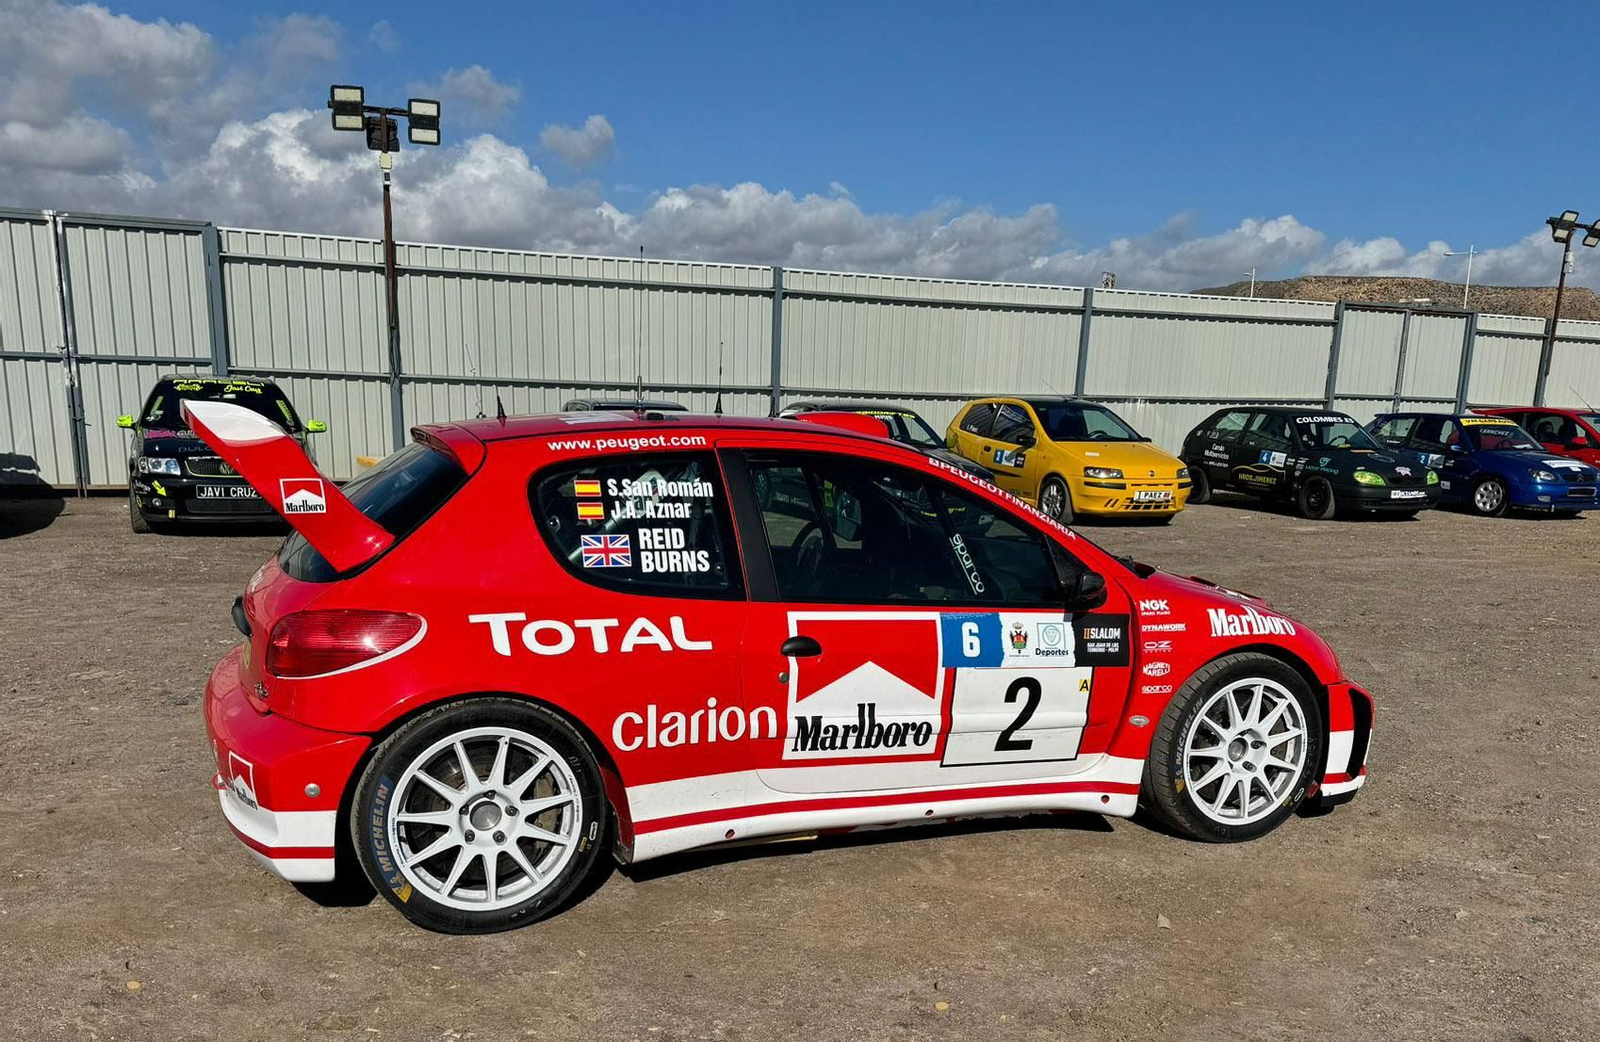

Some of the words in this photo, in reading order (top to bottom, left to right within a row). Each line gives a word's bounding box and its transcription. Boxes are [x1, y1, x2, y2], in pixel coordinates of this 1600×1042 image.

[547, 434, 707, 451] www.peugeot.com
[1420, 455, 1426, 464] 2
[200, 486, 225, 498] JAVI
[230, 487, 258, 498] CRUZ
[606, 478, 653, 497] S.San
[656, 476, 714, 498] Román
[285, 499, 325, 512] Marlboro
[610, 500, 642, 519] J.A.
[646, 500, 692, 519] Aznar
[940, 459, 1004, 497] PEUGEOT
[1004, 490, 1077, 541] FINANZIARIA
[638, 528, 686, 550] REID
[640, 550, 710, 573] BURNS
[952, 532, 986, 594] sparco
[1138, 599, 1170, 612] NGK
[1206, 604, 1296, 637] Marlboro
[468, 612, 712, 656] TOTAL
[961, 621, 981, 658] 6
[1090, 628, 1120, 639] SLALOM
[1144, 640, 1172, 649] OZ
[1035, 648, 1069, 656] Deportes
[1078, 680, 1090, 691] A
[1142, 684, 1172, 694] sparco
[612, 696, 777, 752] clarion
[994, 676, 1042, 752] 2
[791, 702, 933, 752] Marlboro
[375, 783, 393, 873] MICHELIN
